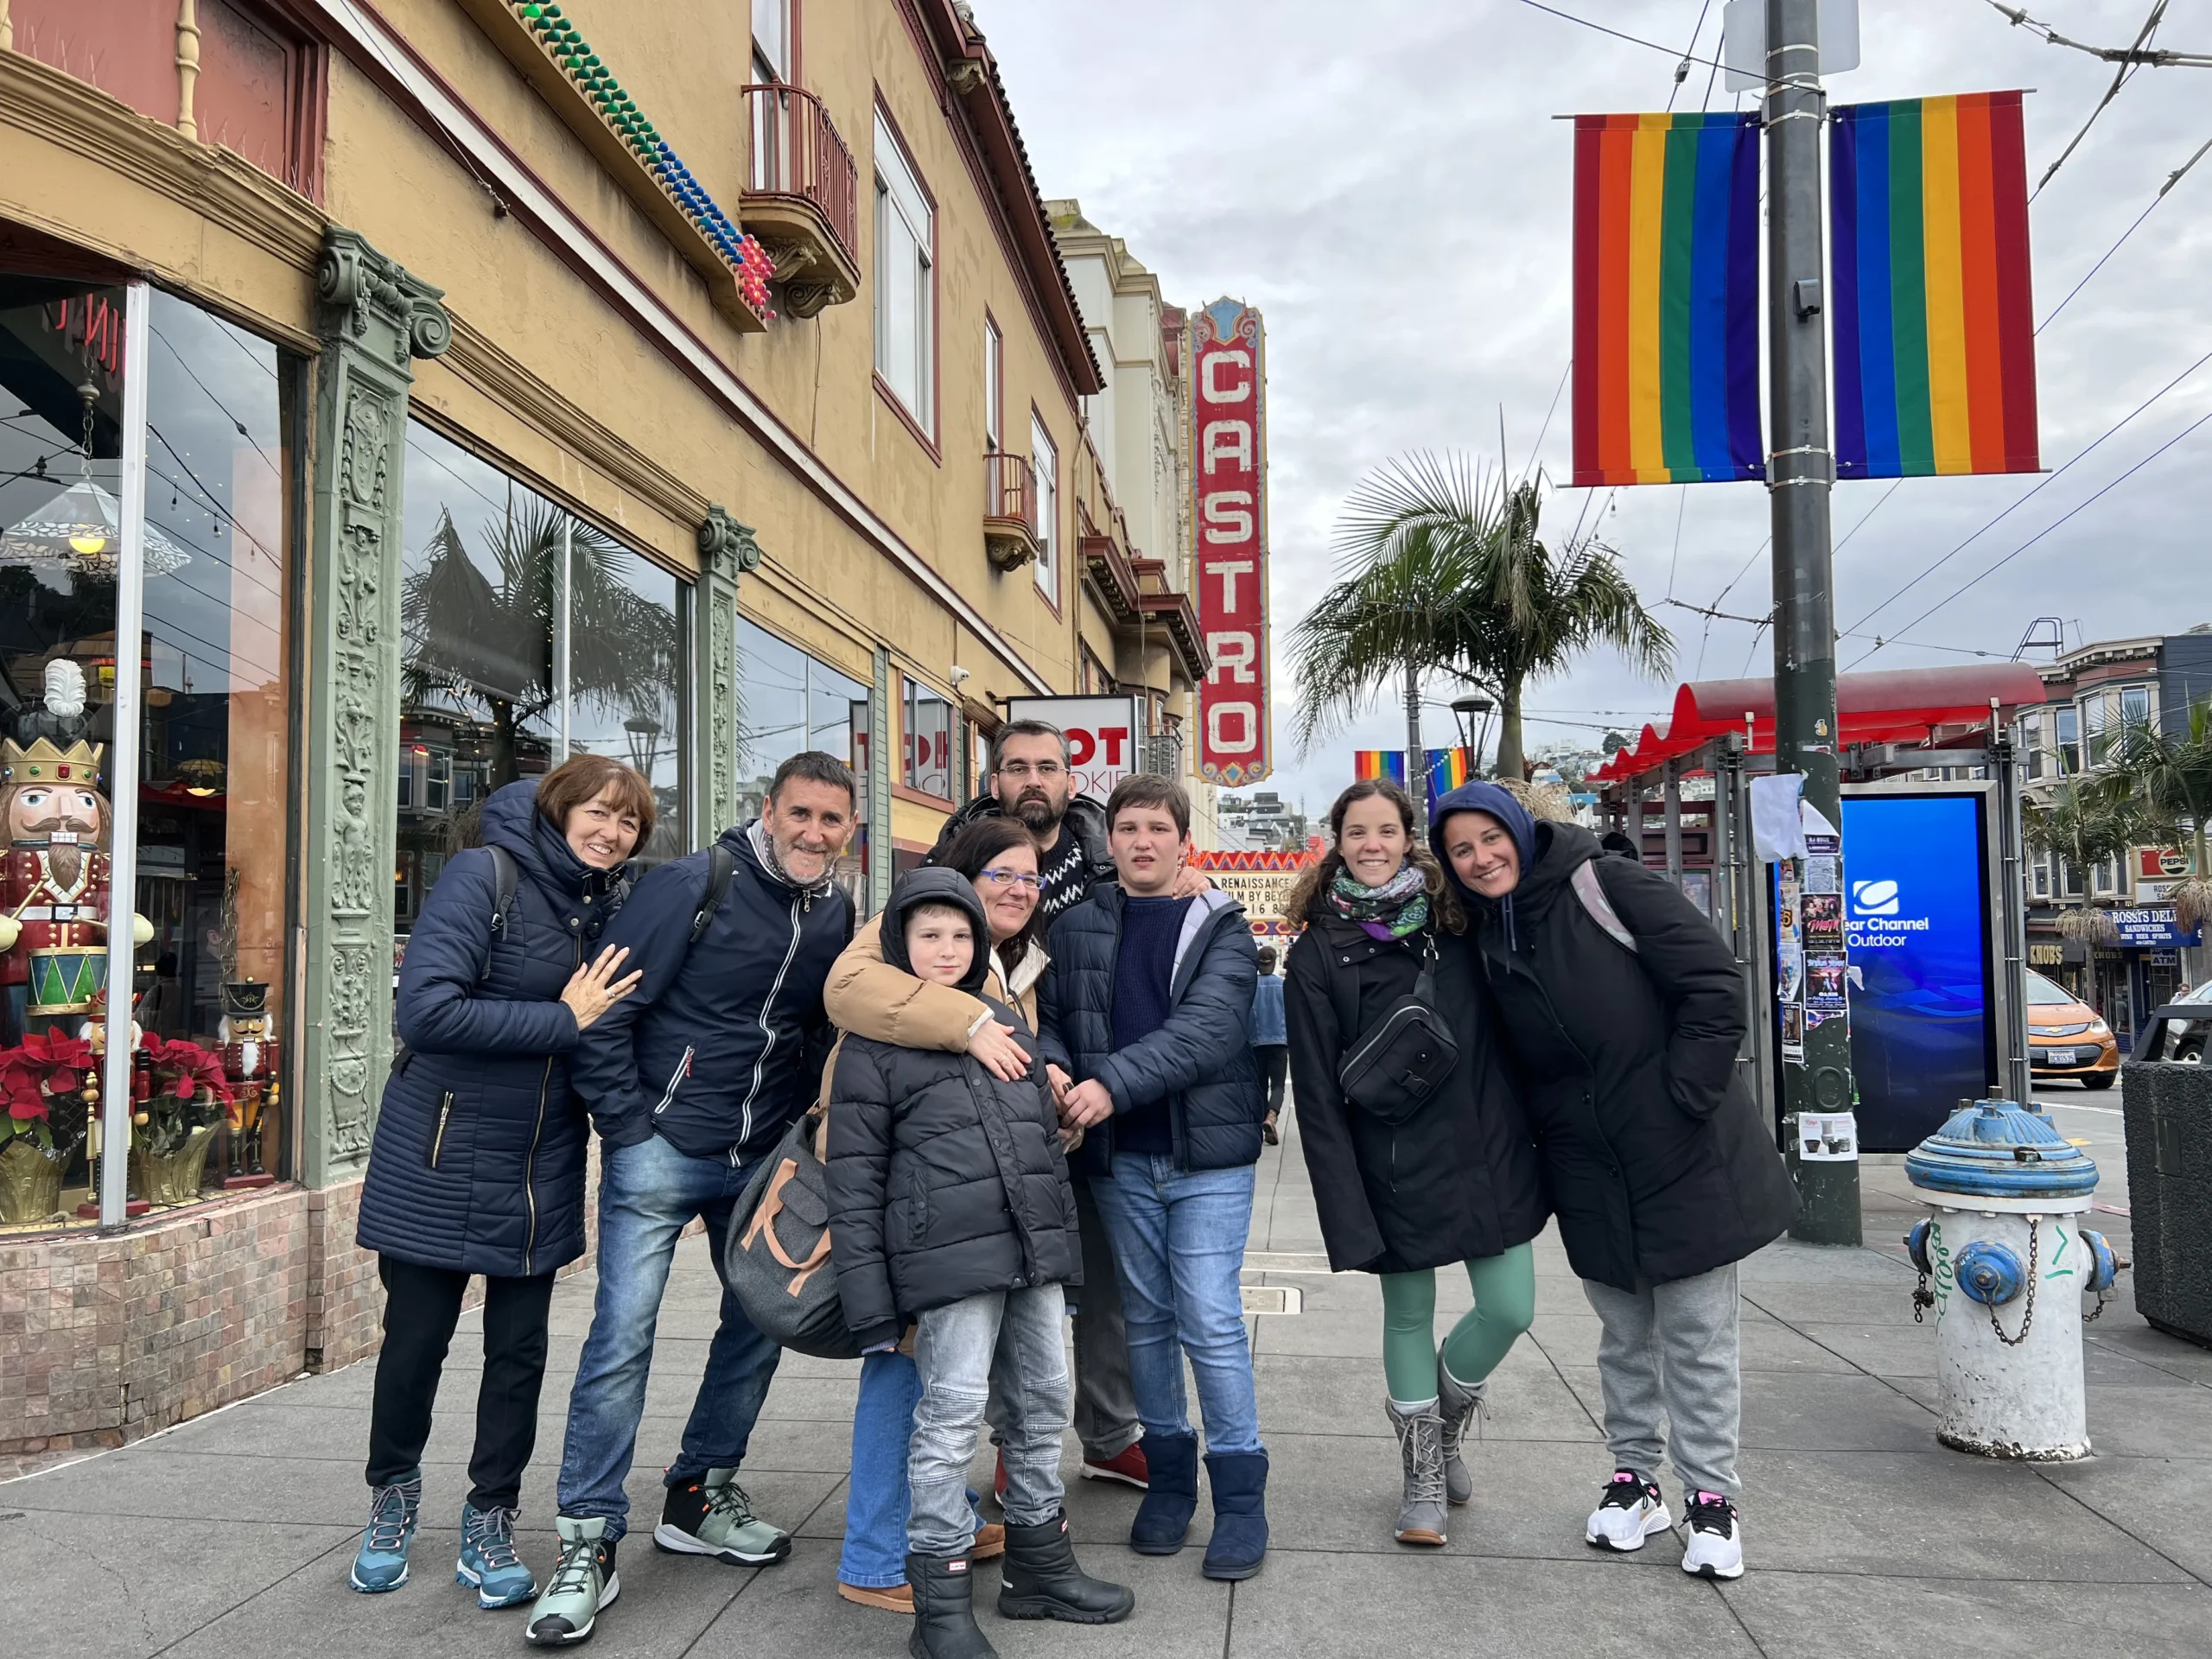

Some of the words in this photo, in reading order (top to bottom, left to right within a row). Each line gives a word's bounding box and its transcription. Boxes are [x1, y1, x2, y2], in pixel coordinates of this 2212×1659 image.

[1201, 350, 1256, 753] CASTRO
[1062, 727, 1128, 766] OT
[2160, 856, 2189, 865] PEPSI
[1249, 891, 1261, 901] BY
[1845, 920, 1866, 931] ear
[1867, 917, 1929, 931] Channel
[2125, 924, 2165, 932] SANDWICHES
[1847, 933, 1907, 947] Outdoor
[2031, 945, 2063, 965] KNOBS
